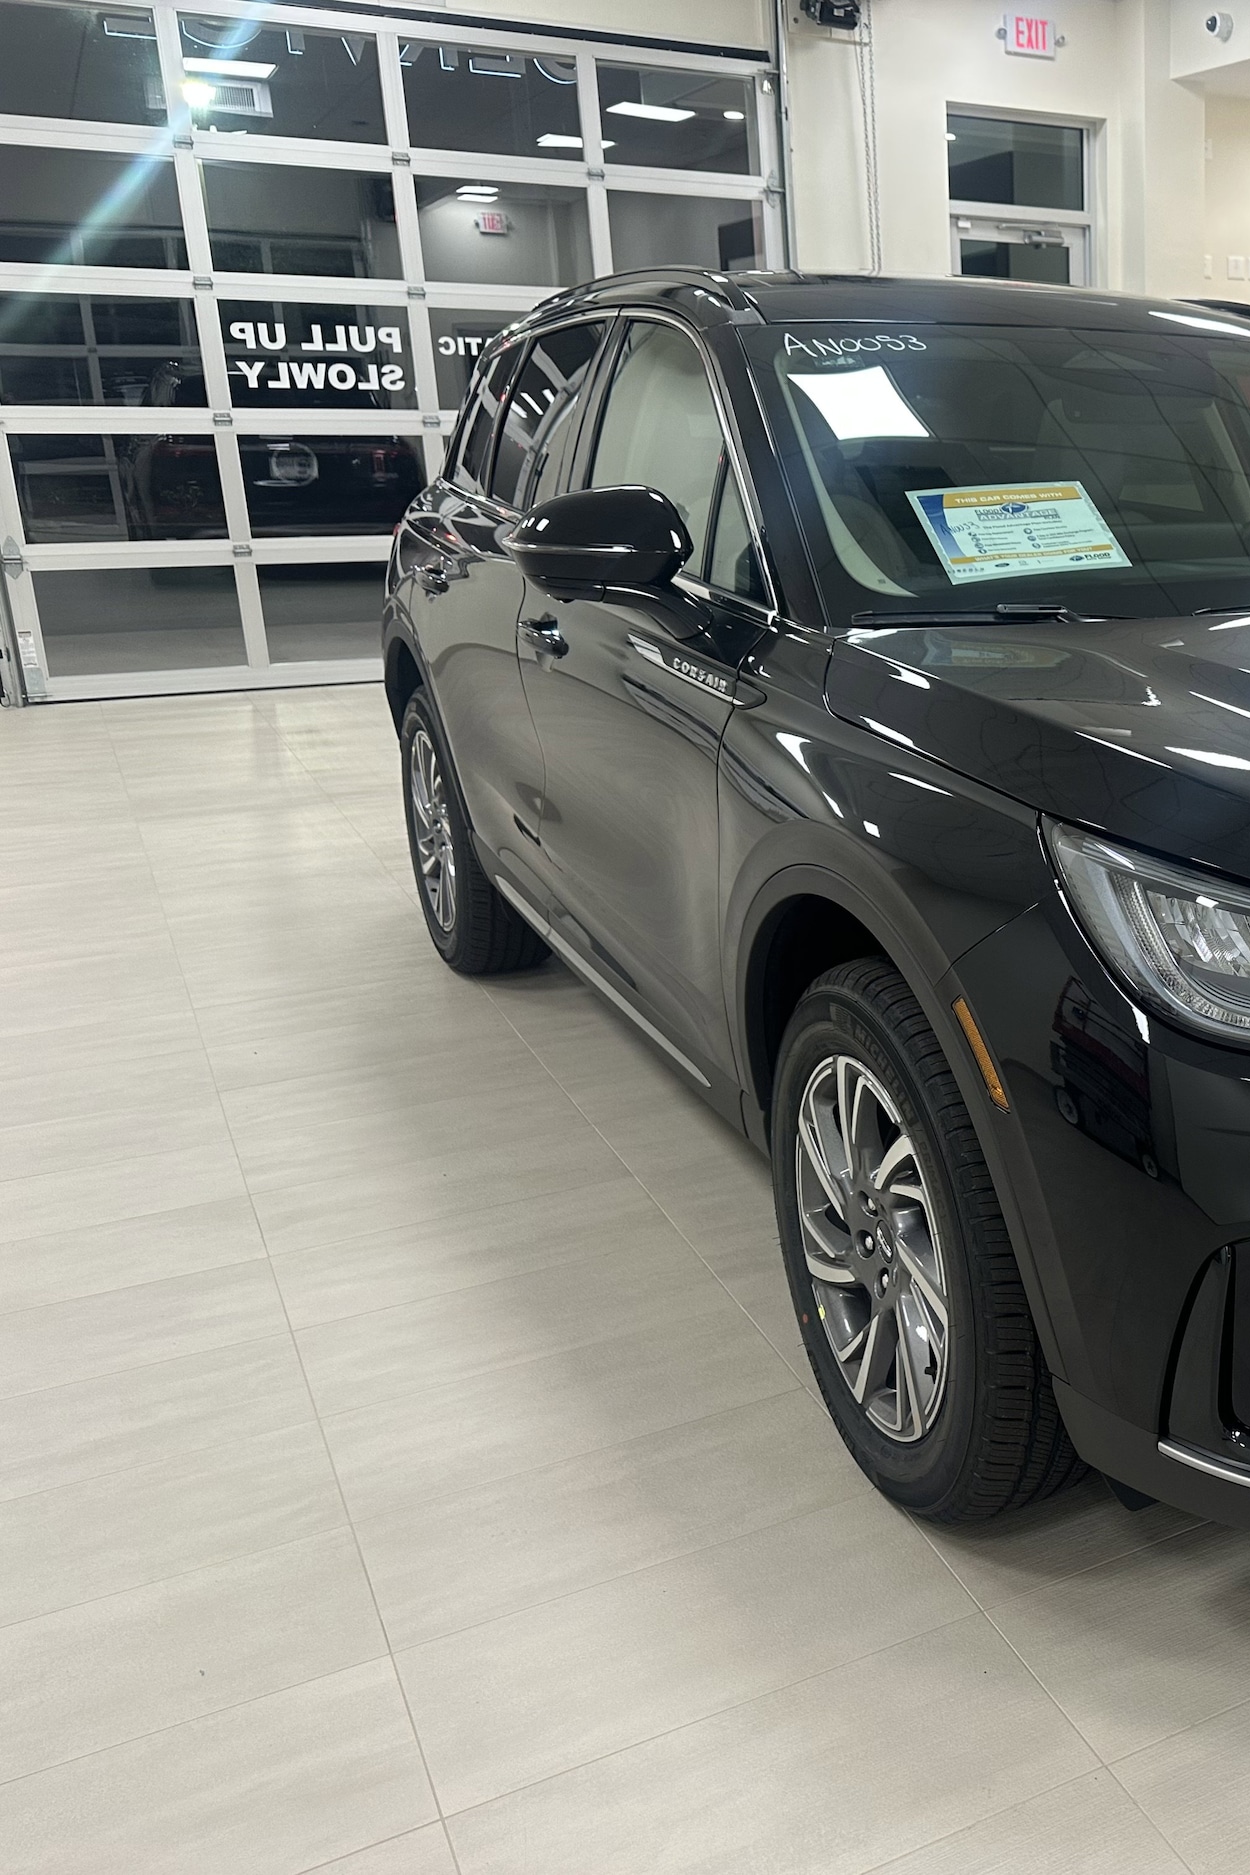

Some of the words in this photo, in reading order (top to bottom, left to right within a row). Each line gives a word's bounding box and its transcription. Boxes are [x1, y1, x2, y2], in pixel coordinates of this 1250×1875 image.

[1015, 16, 1048, 51] EXIT
[955, 497, 978, 505] THIS
[1003, 493, 1037, 501] COMES
[1038, 491, 1063, 499] WITH
[978, 508, 1058, 521] ADVANTAGE
[673, 657, 728, 693] CORSAIR
[854, 1023, 917, 1123] MICHELIN
